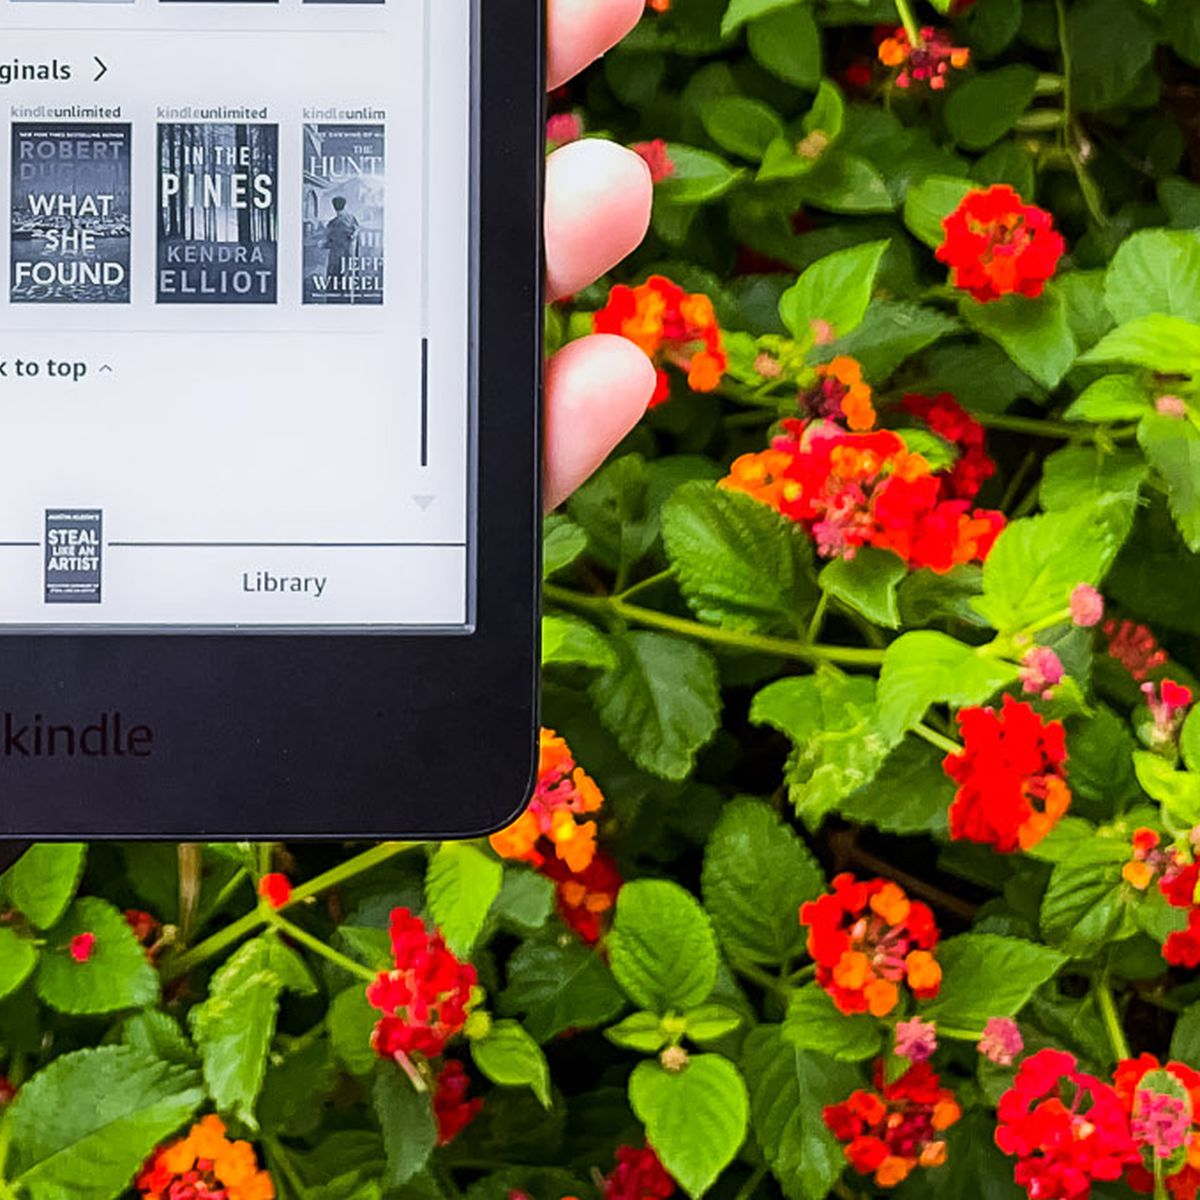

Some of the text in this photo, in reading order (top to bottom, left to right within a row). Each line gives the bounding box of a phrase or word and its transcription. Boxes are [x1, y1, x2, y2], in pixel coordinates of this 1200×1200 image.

[10, 106, 121, 119] kindleunlimited
[156, 106, 268, 120] kindleunlimited
[20, 140, 124, 159] ROBERT
[184, 146, 250, 166] IN THE
[310, 155, 383, 178] HUNT
[161, 173, 273, 210] PINES
[28, 194, 114, 217] WHAT
[45, 229, 97, 253] SHE
[167, 245, 264, 264] KENDRA
[15, 262, 125, 286] FOUND
[160, 269, 272, 294] ELLIOT
[15, 359, 40, 377] to
[46, 359, 88, 382] top
[48, 529, 100, 546] STEAL
[78, 546, 96, 557] AN
[48, 557, 100, 571] ARTIST
[242, 572, 328, 596] Library
[4, 711, 155, 758] kindle
